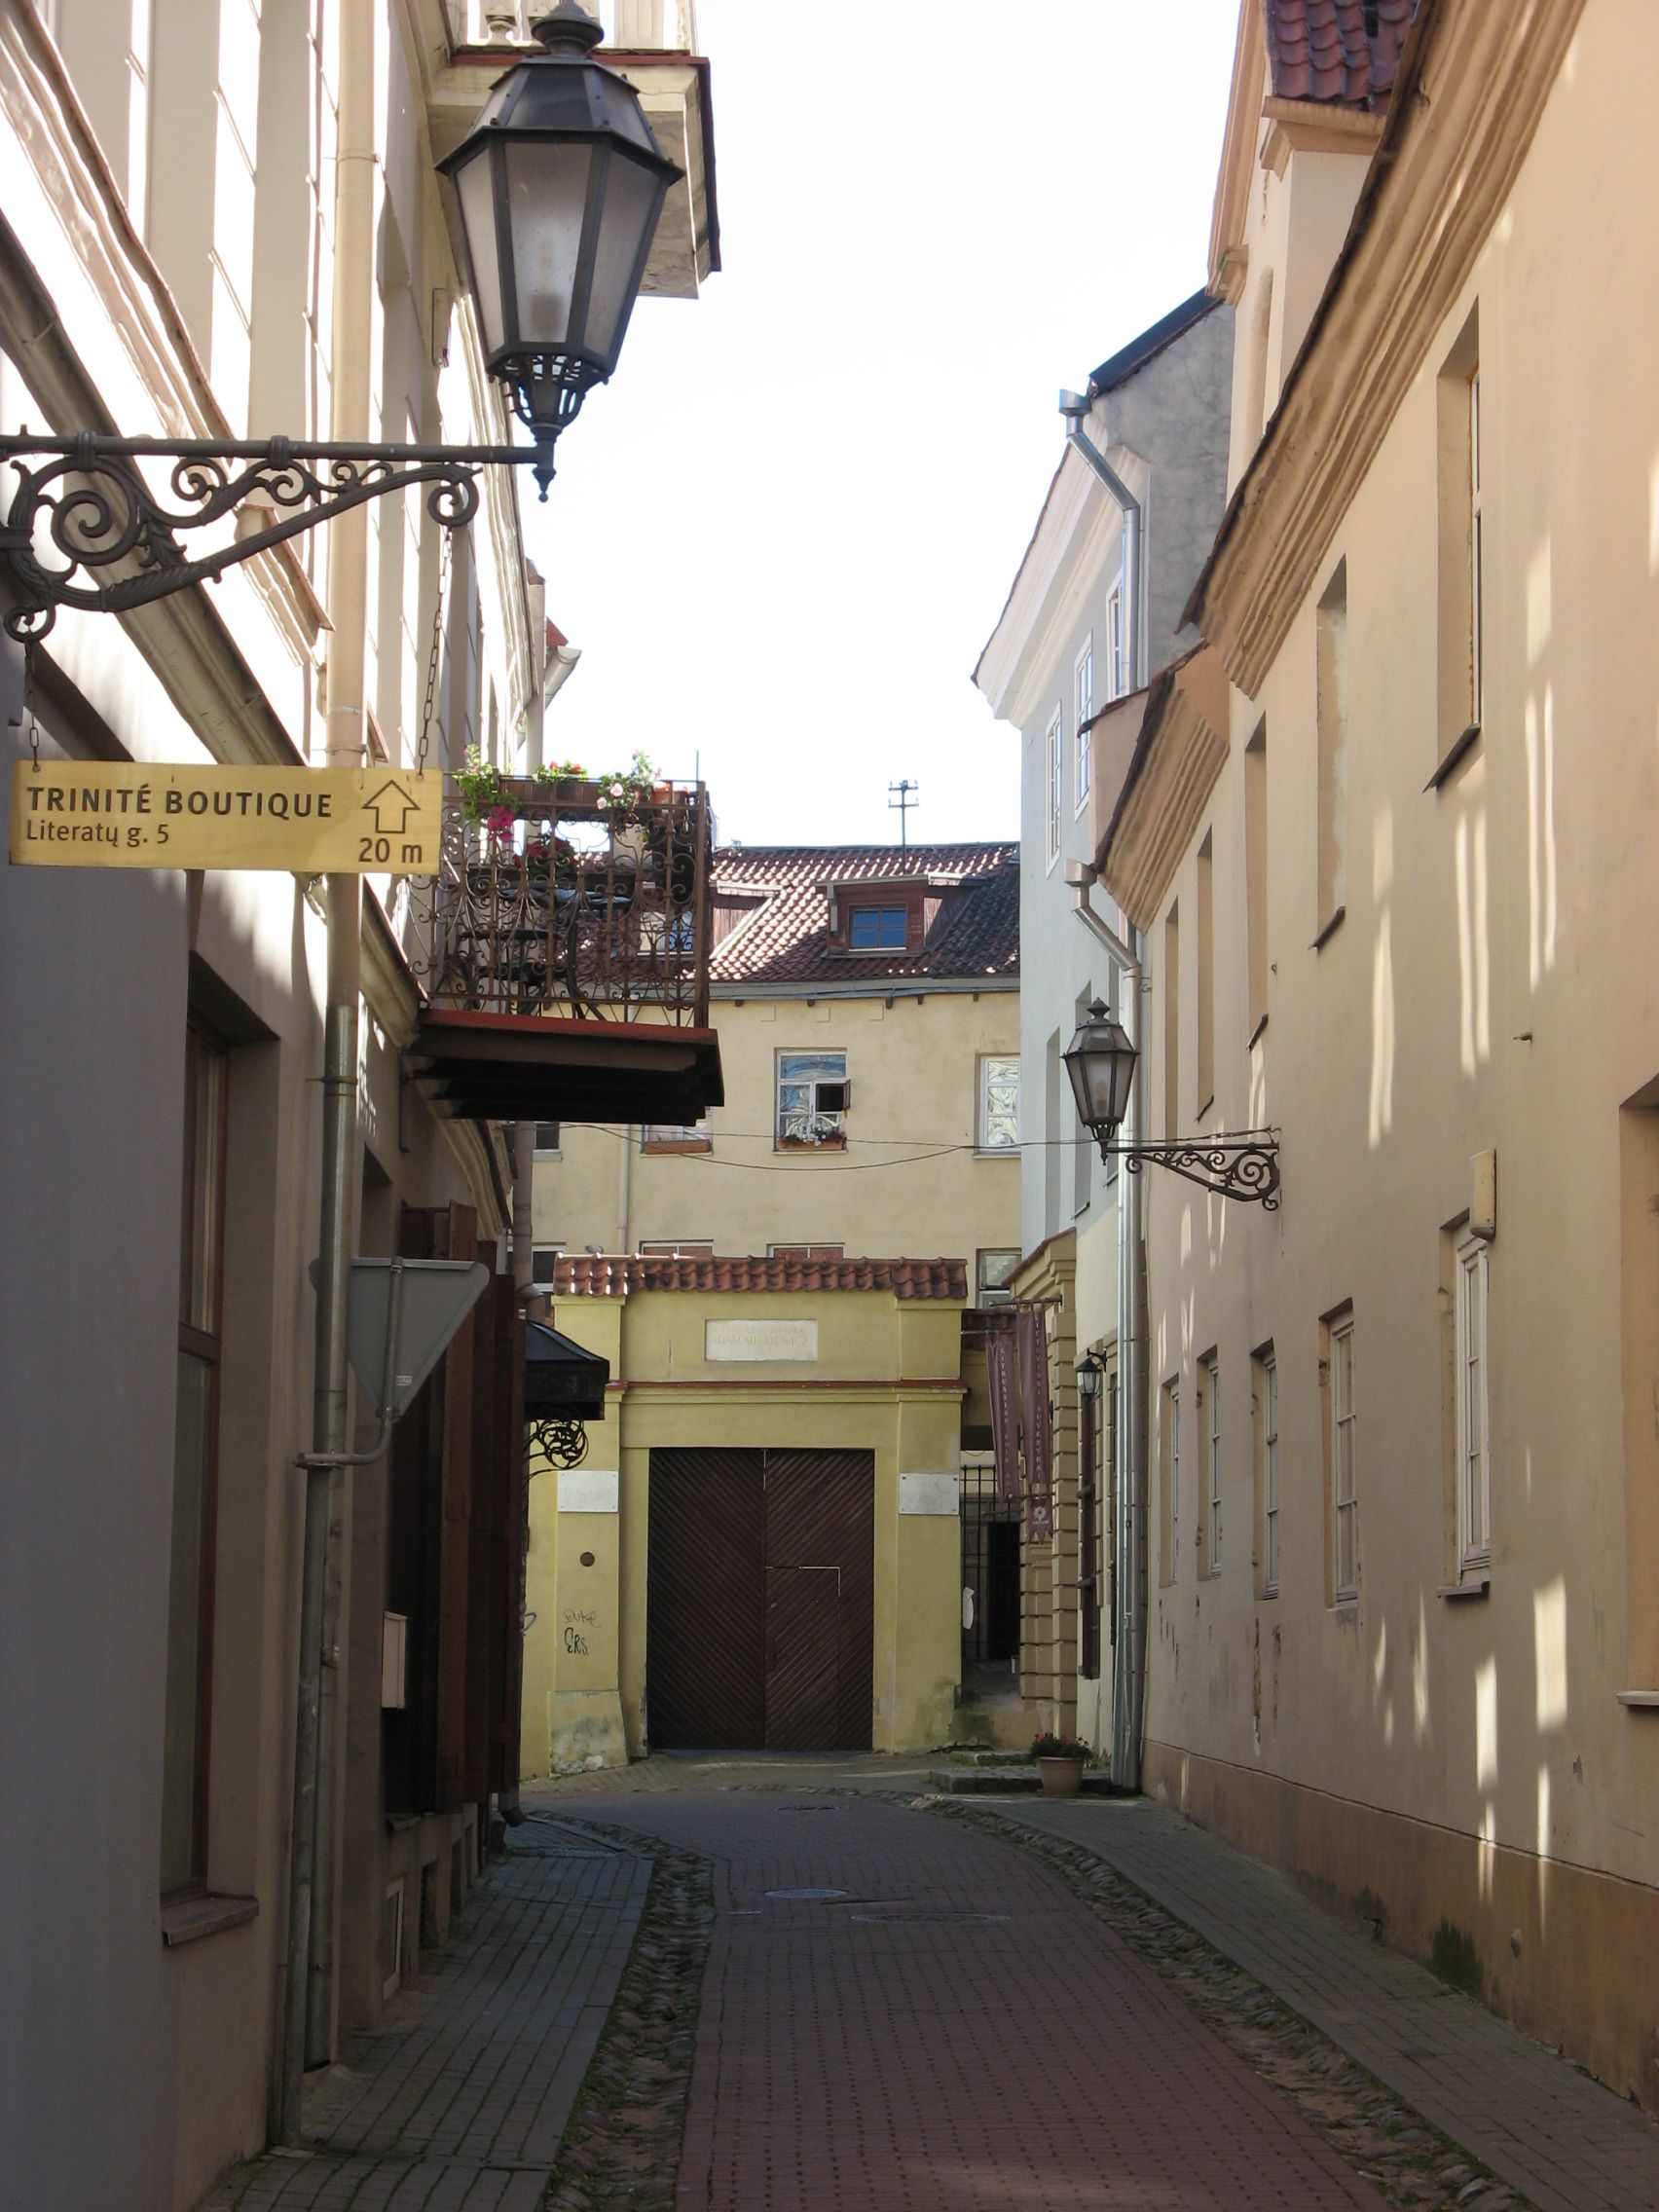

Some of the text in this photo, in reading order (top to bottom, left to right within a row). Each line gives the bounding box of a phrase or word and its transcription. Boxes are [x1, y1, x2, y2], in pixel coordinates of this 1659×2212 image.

[26, 783, 332, 821] TRINITÉ BOUTIQUE
[26, 819, 169, 848] Literatų g. 5
[358, 837, 423, 864] 20 m
